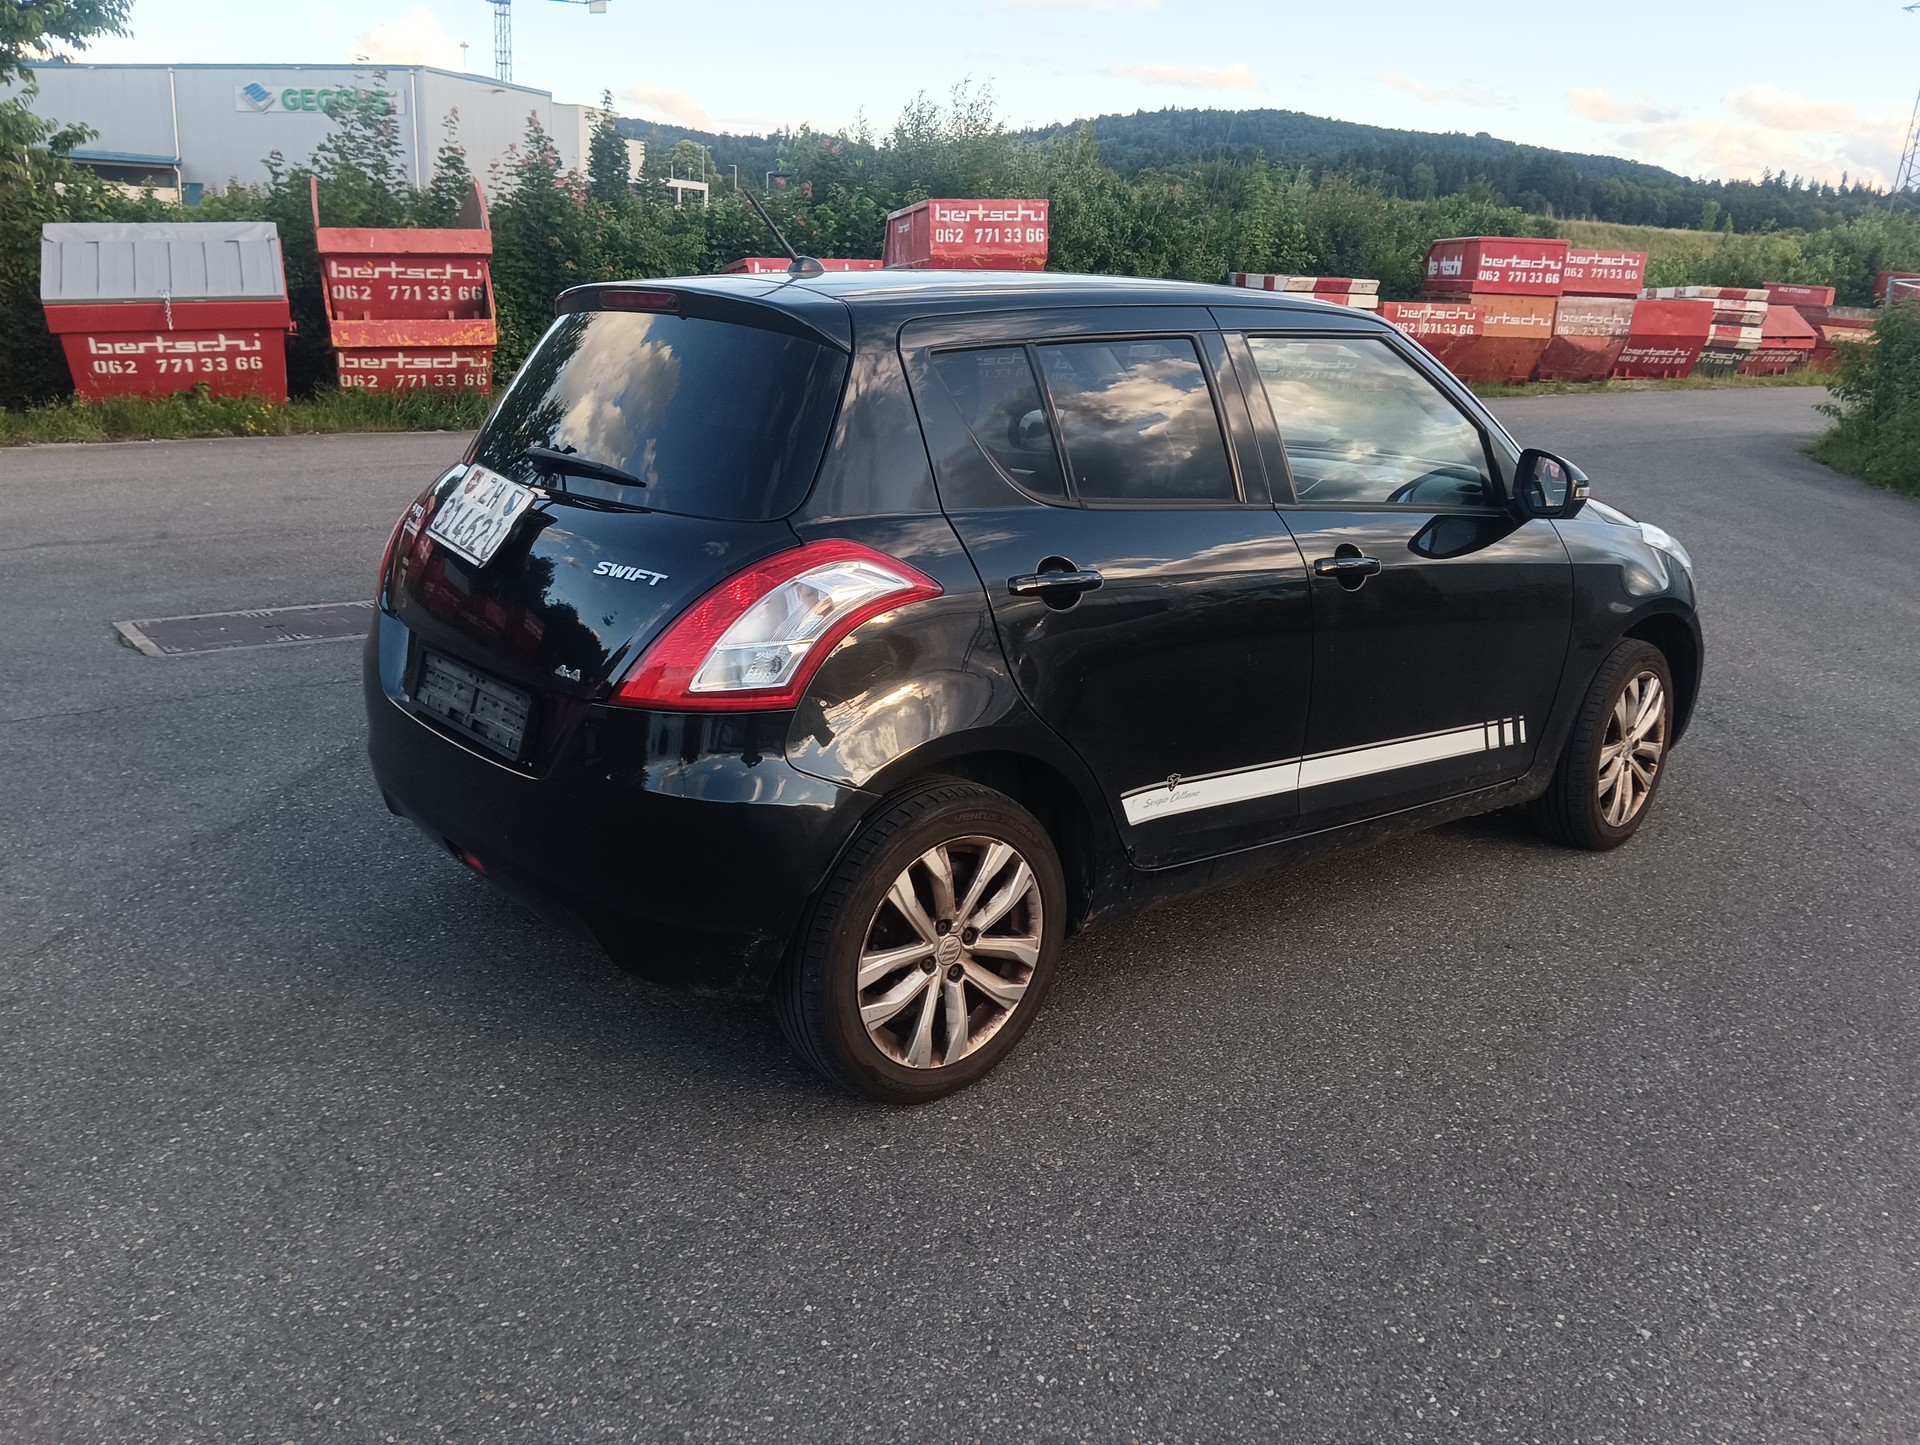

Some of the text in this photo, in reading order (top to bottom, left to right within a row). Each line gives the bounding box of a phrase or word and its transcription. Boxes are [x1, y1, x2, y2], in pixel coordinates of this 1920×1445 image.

[935, 203, 1045, 222] bertschi
[935, 228, 1045, 244] 062 771 33 66
[1481, 253, 1563, 270] bertschi
[1566, 252, 1640, 266] bertschi
[331, 260, 483, 280] bertschi
[1479, 271, 1560, 284] 062 771 33 66
[1564, 267, 1638, 280] 062 771 33 66
[332, 284, 483, 300] 062 771 33 66
[1397, 304, 1477, 320] bertschi
[1484, 312, 1552, 327] ertschi
[1559, 311, 1632, 326] bertschi
[1424, 323, 1441, 333] 771
[1444, 323, 1457, 335] 33
[1460, 324, 1474, 335] 66
[88, 333, 262, 354] bertschi
[1622, 346, 1693, 356] bertschi
[93, 356, 263, 374] 062 771 33 66
[338, 351, 488, 369] bertschi
[1618, 355, 1636, 363] 062
[1642, 356, 1660, 364] 771
[1660, 356, 1673, 364] 33
[339, 373, 488, 388] 062 771 33 66
[592, 561, 669, 586] SWIFT
[1143, 796, 1169, 809] Sergio
